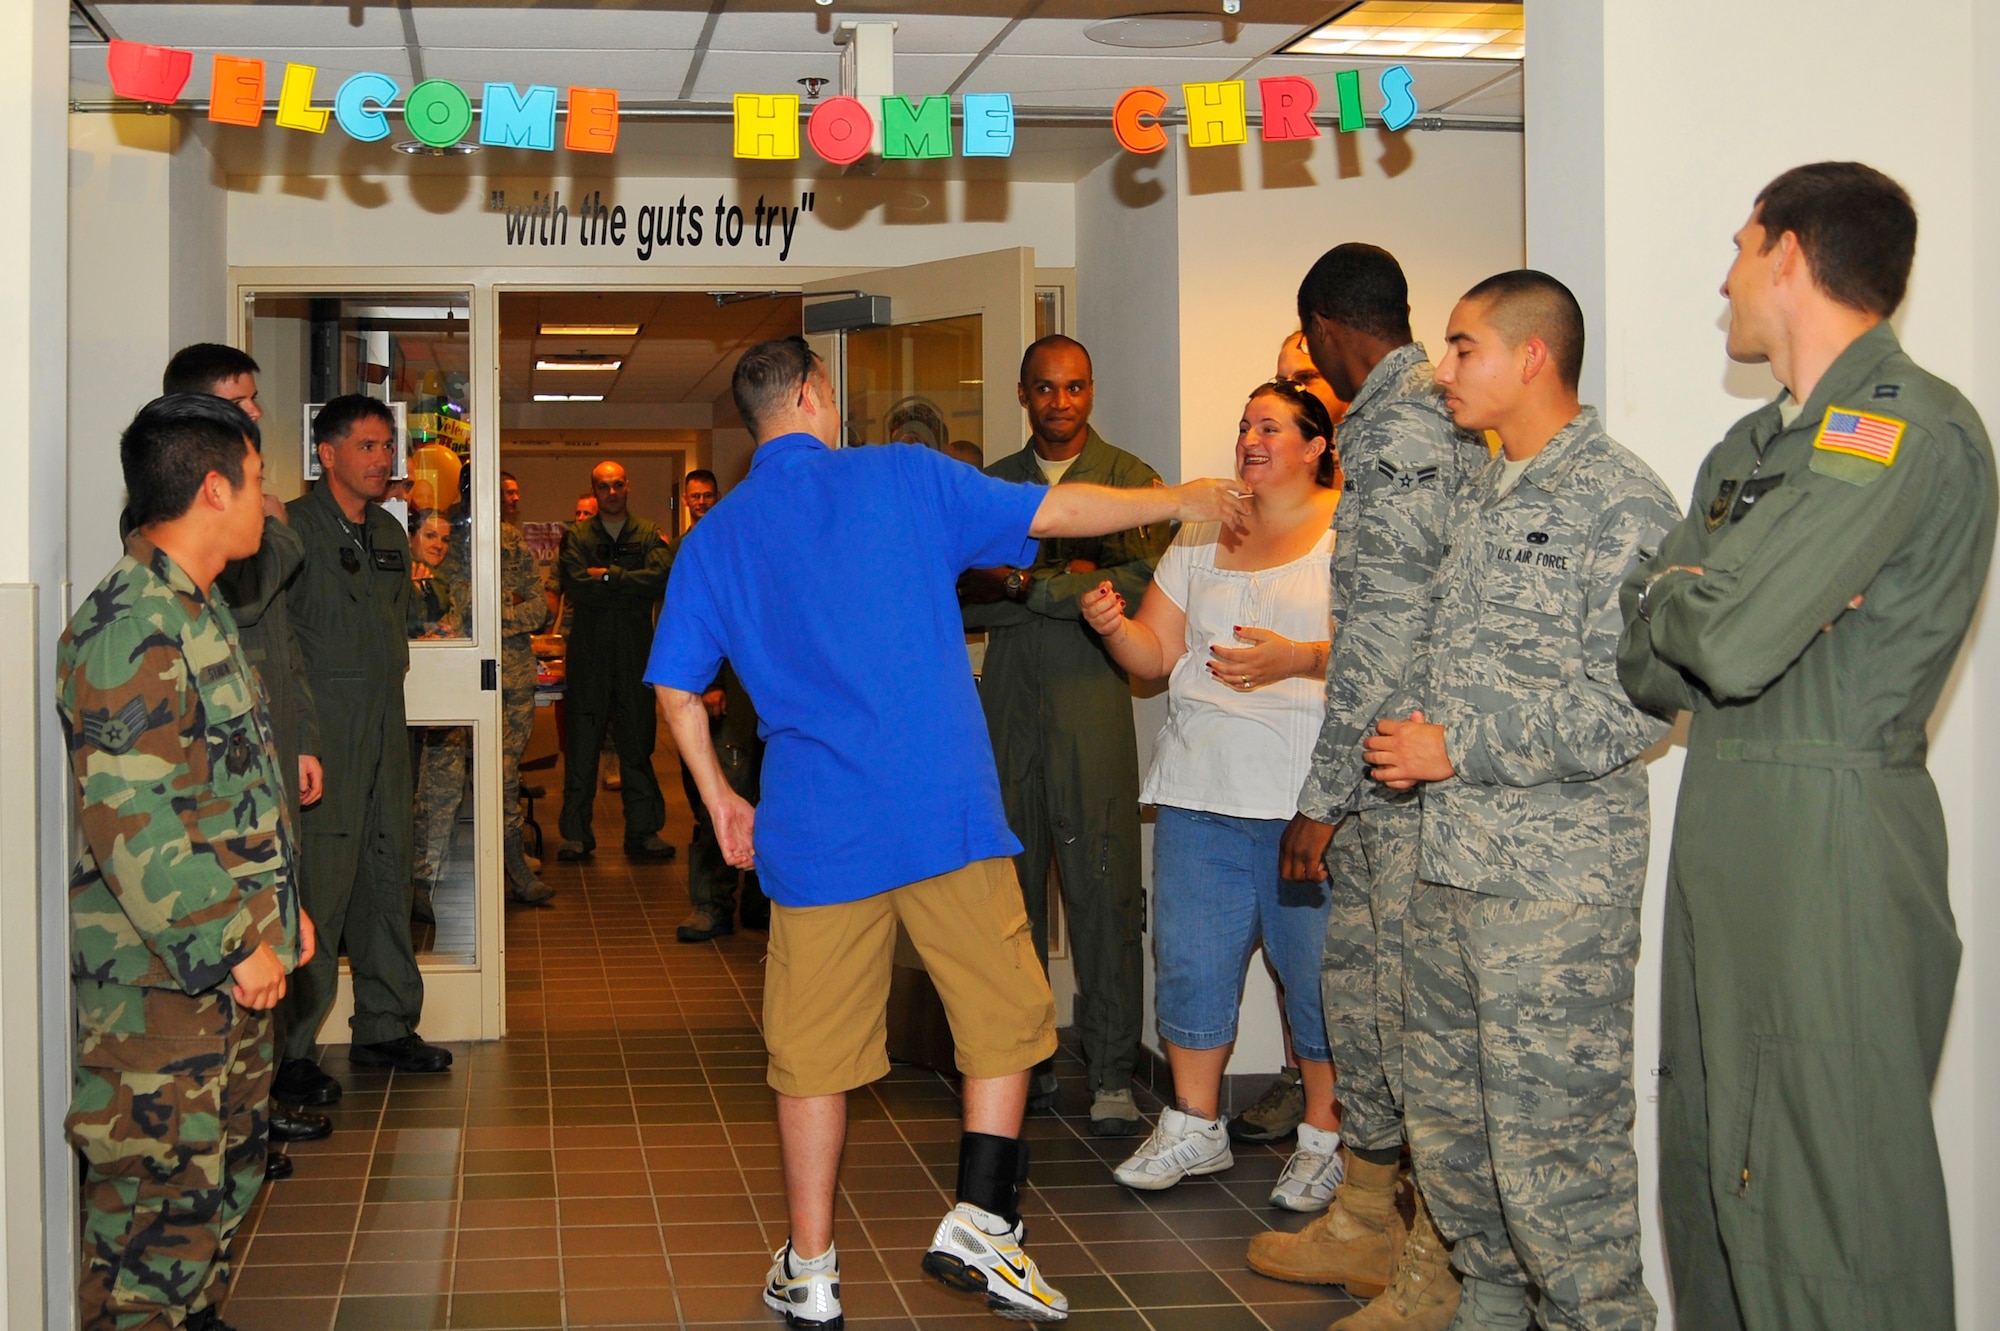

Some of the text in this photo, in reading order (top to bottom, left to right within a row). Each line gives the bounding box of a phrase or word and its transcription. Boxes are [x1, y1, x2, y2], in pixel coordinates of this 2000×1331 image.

[106, 38, 1417, 164] WELCOME HOME CHRIS
[580, 191, 627, 246] the
[637, 194, 704, 261] guts
[716, 194, 744, 246] to
[755, 192, 815, 262] try"
[1514, 549, 1533, 564] AIR
[1536, 552, 1569, 570] FORCE
